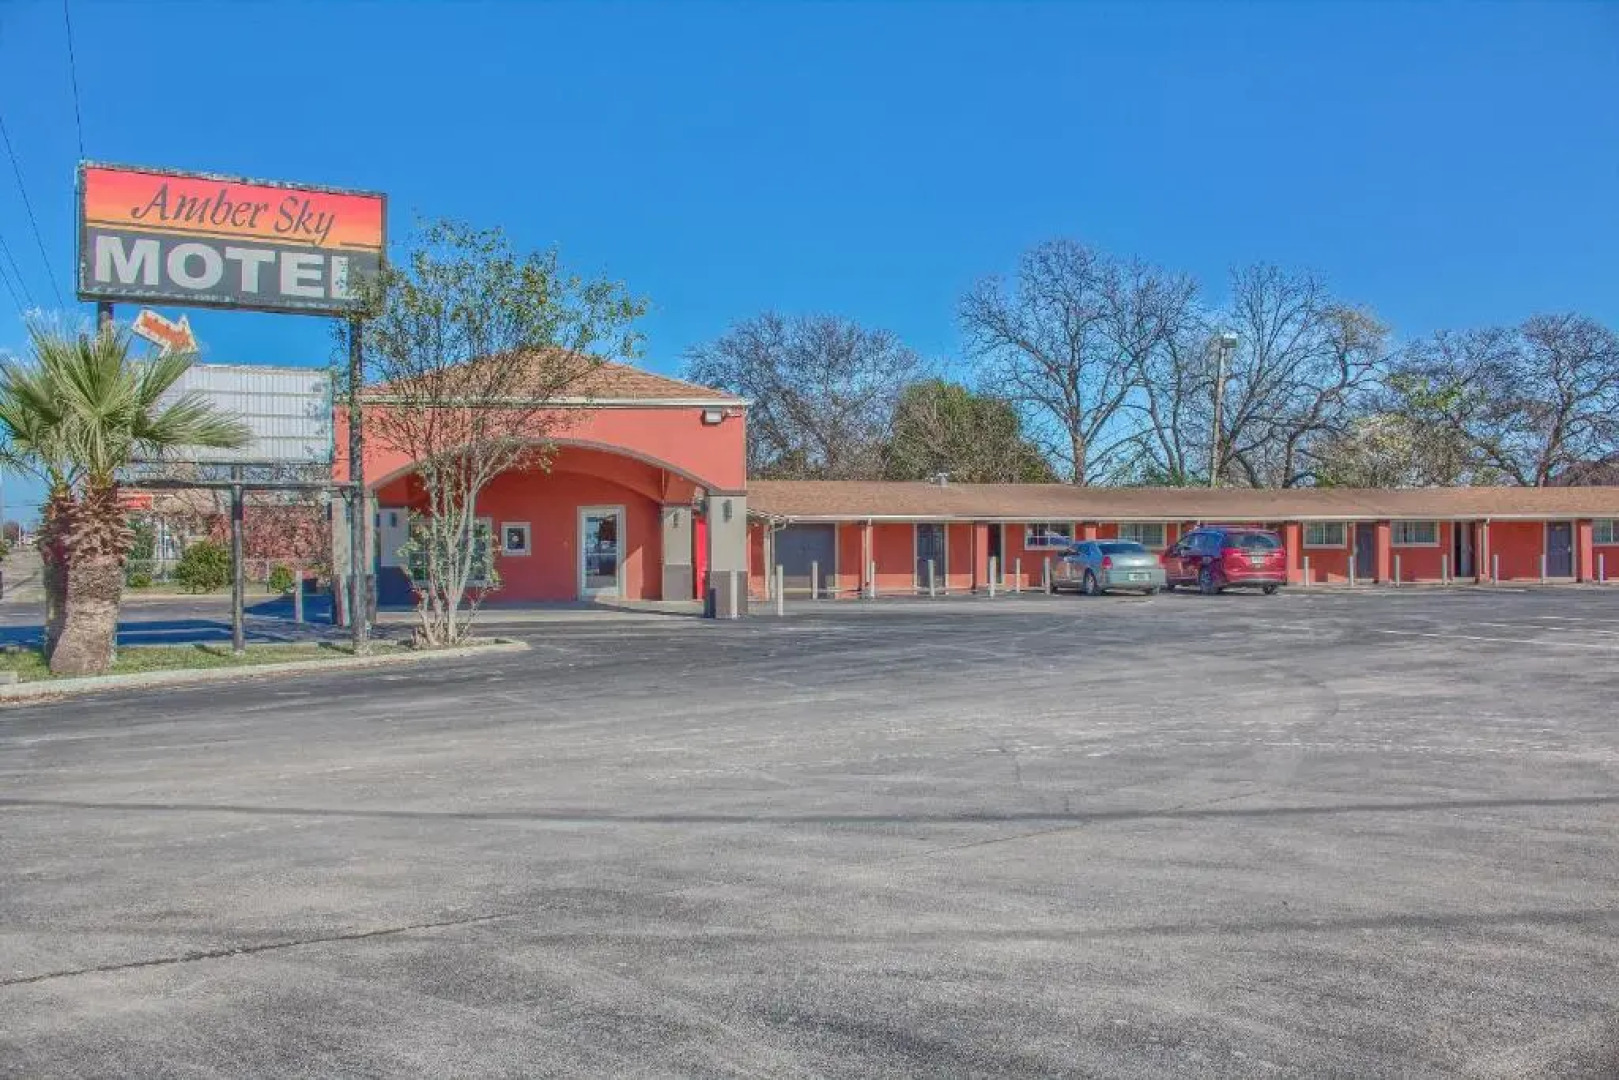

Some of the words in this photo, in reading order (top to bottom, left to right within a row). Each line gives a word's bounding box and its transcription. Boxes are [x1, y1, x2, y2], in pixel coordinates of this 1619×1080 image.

[131, 184, 269, 228] Amber
[274, 196, 335, 246] Sky
[94, 235, 361, 300] MOTEL
